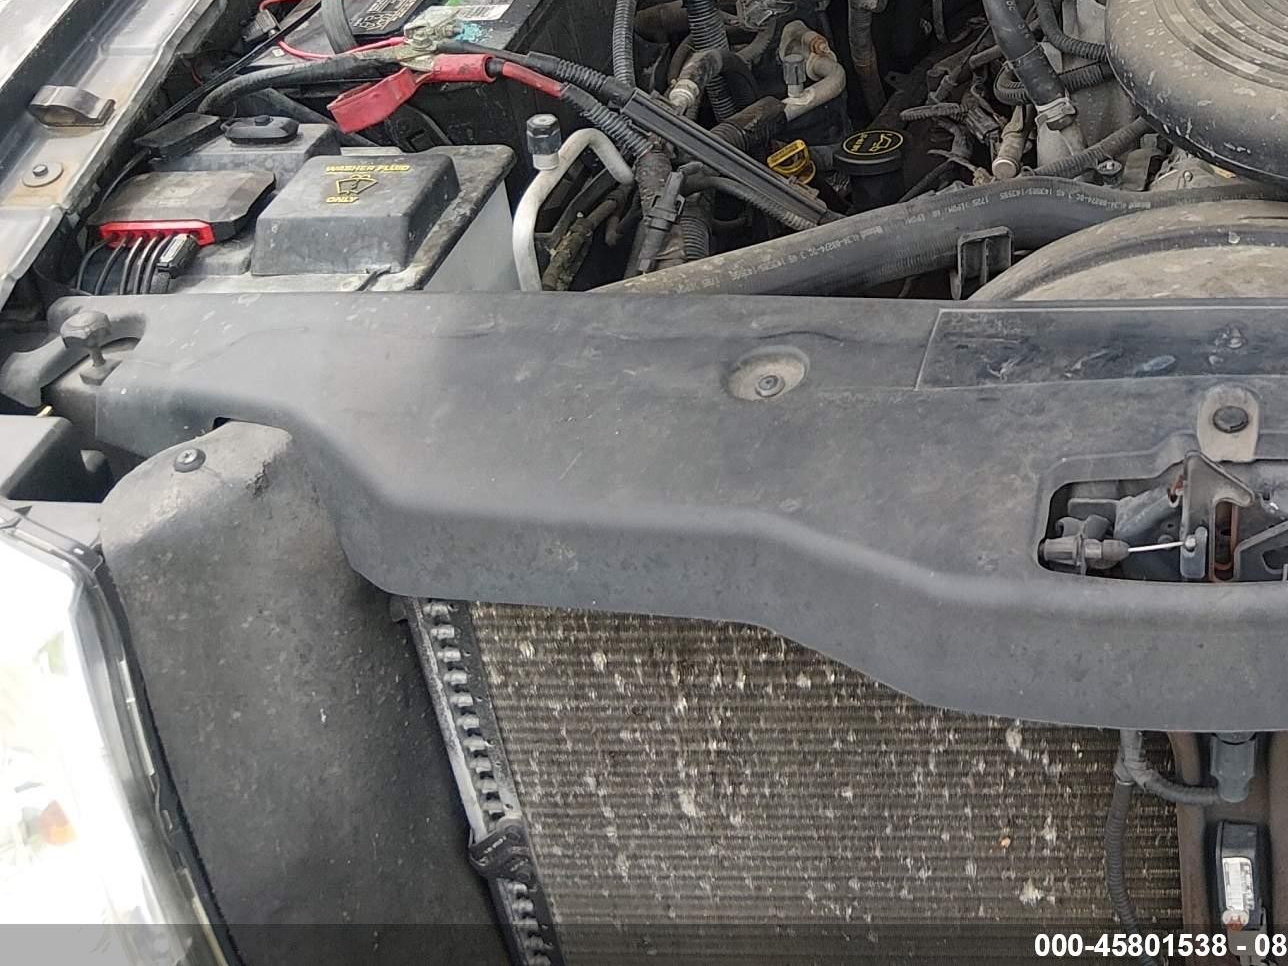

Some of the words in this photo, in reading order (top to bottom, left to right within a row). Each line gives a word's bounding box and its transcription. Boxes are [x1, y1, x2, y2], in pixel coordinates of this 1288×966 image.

[325, 164, 376, 173] WASHER
[375, 164, 411, 172] FLUID
[325, 196, 359, 204] ONLY
